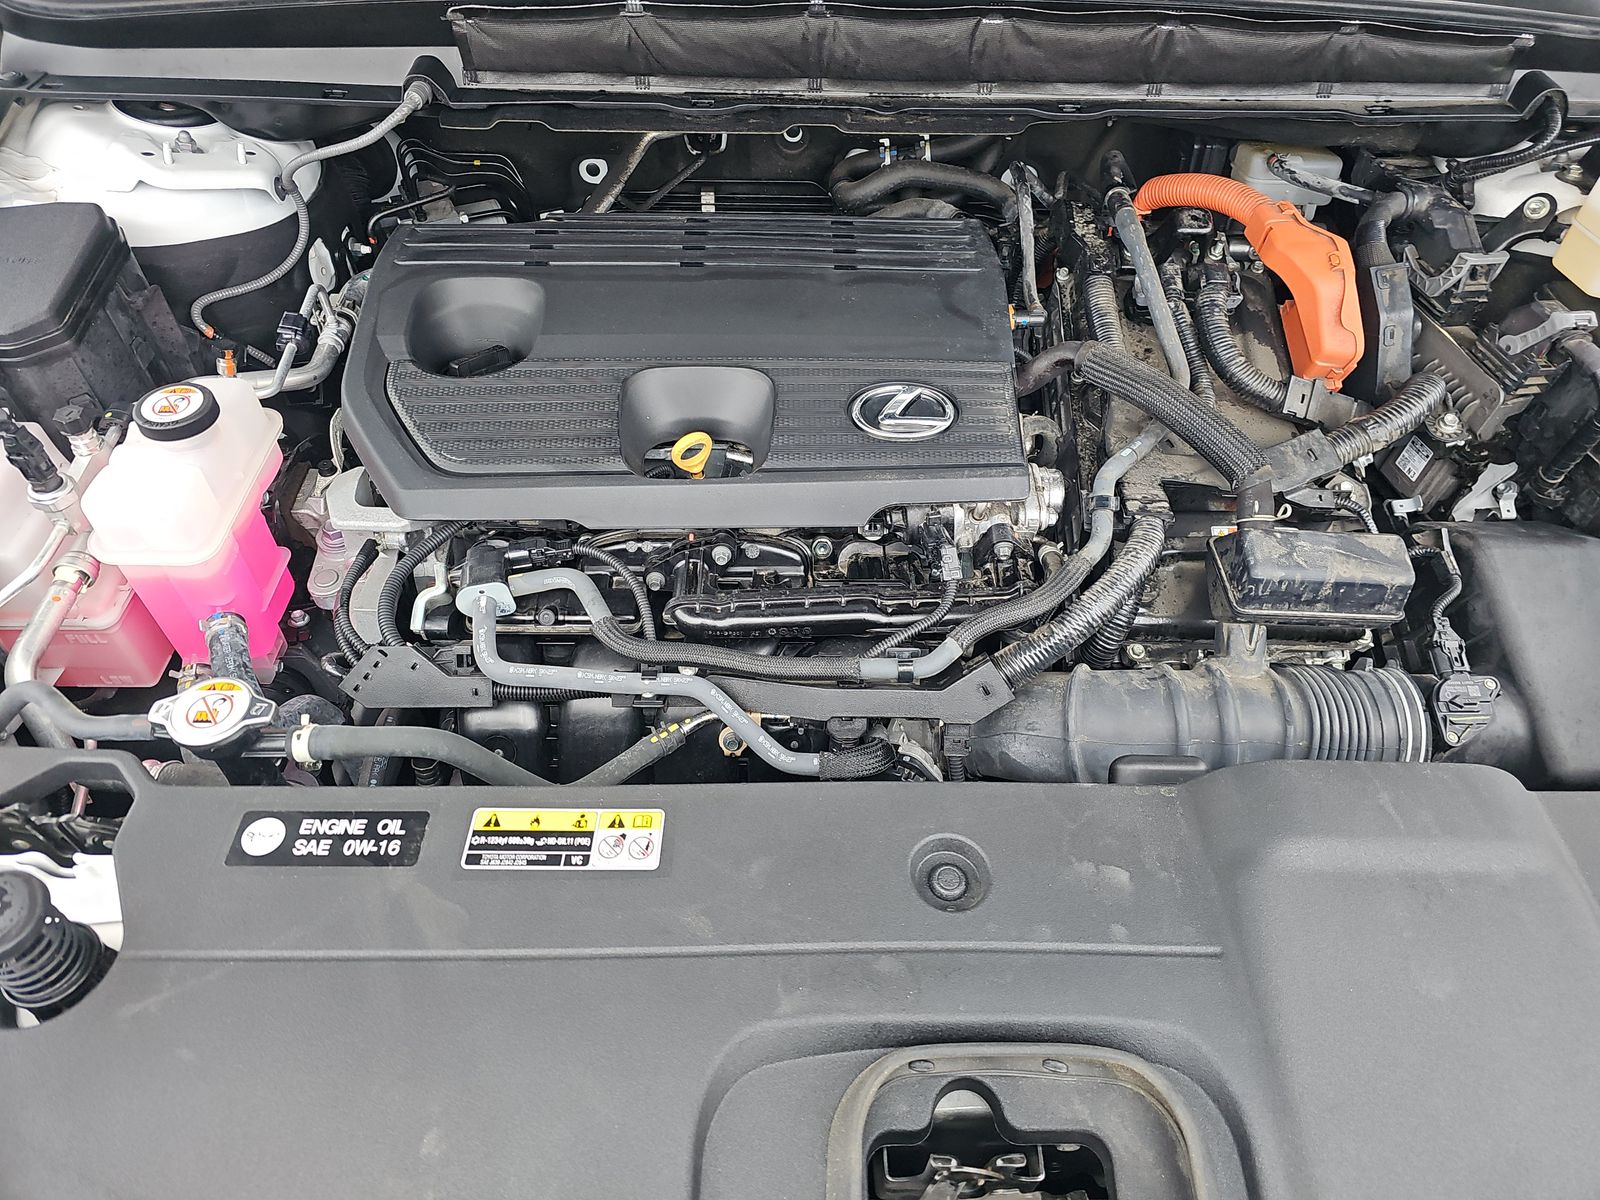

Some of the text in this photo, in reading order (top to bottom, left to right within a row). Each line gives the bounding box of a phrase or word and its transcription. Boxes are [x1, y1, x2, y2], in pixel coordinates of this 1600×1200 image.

[64, 634, 108, 644] FULL
[298, 818, 406, 835] ENGINE OIL
[292, 839, 402, 856] SAE 0W-16
[570, 856, 583, 865] VC
